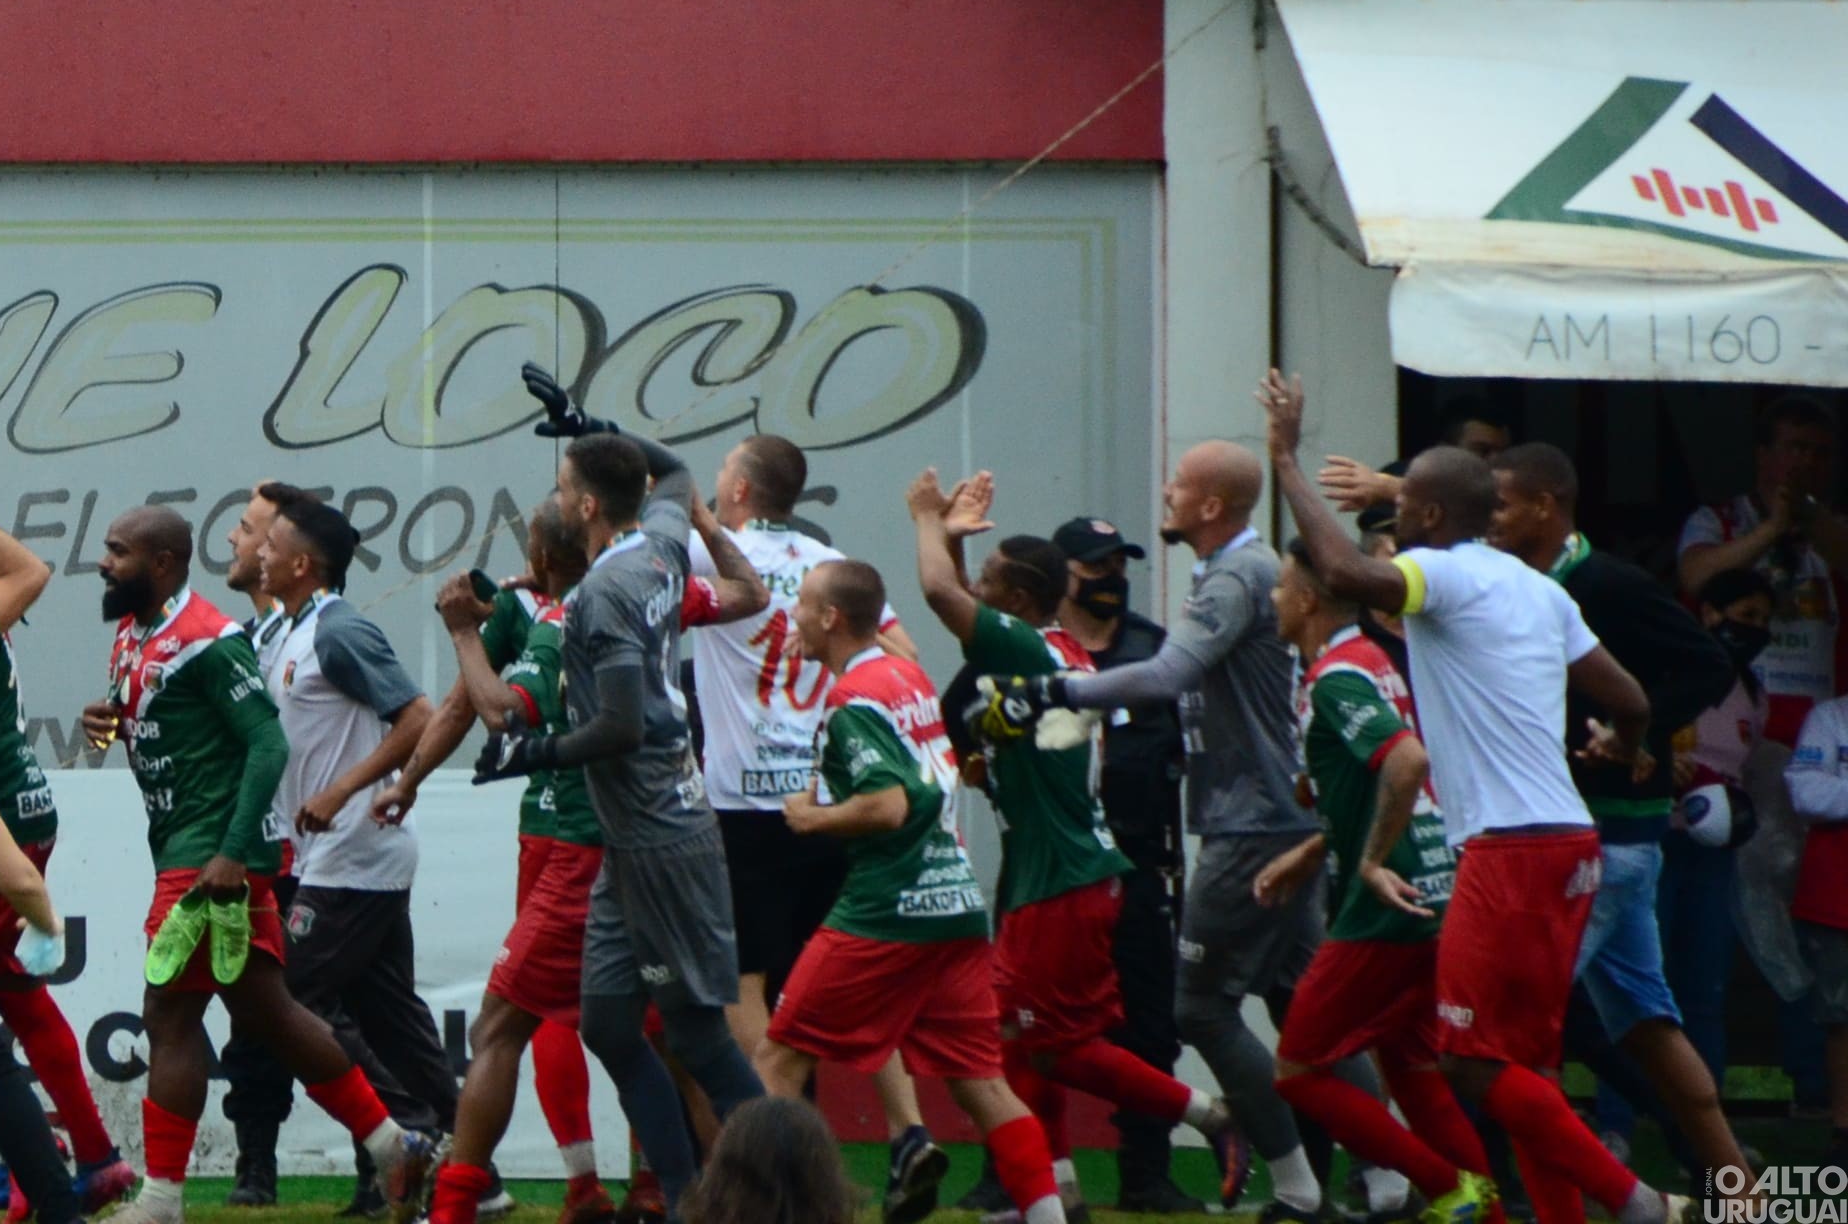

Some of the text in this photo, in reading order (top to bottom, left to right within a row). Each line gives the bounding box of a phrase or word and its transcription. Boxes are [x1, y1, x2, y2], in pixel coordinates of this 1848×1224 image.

[262, 263, 987, 451] LOCO
[1526, 314, 1609, 361] AM
[1650, 313, 1781, 365] 1160
